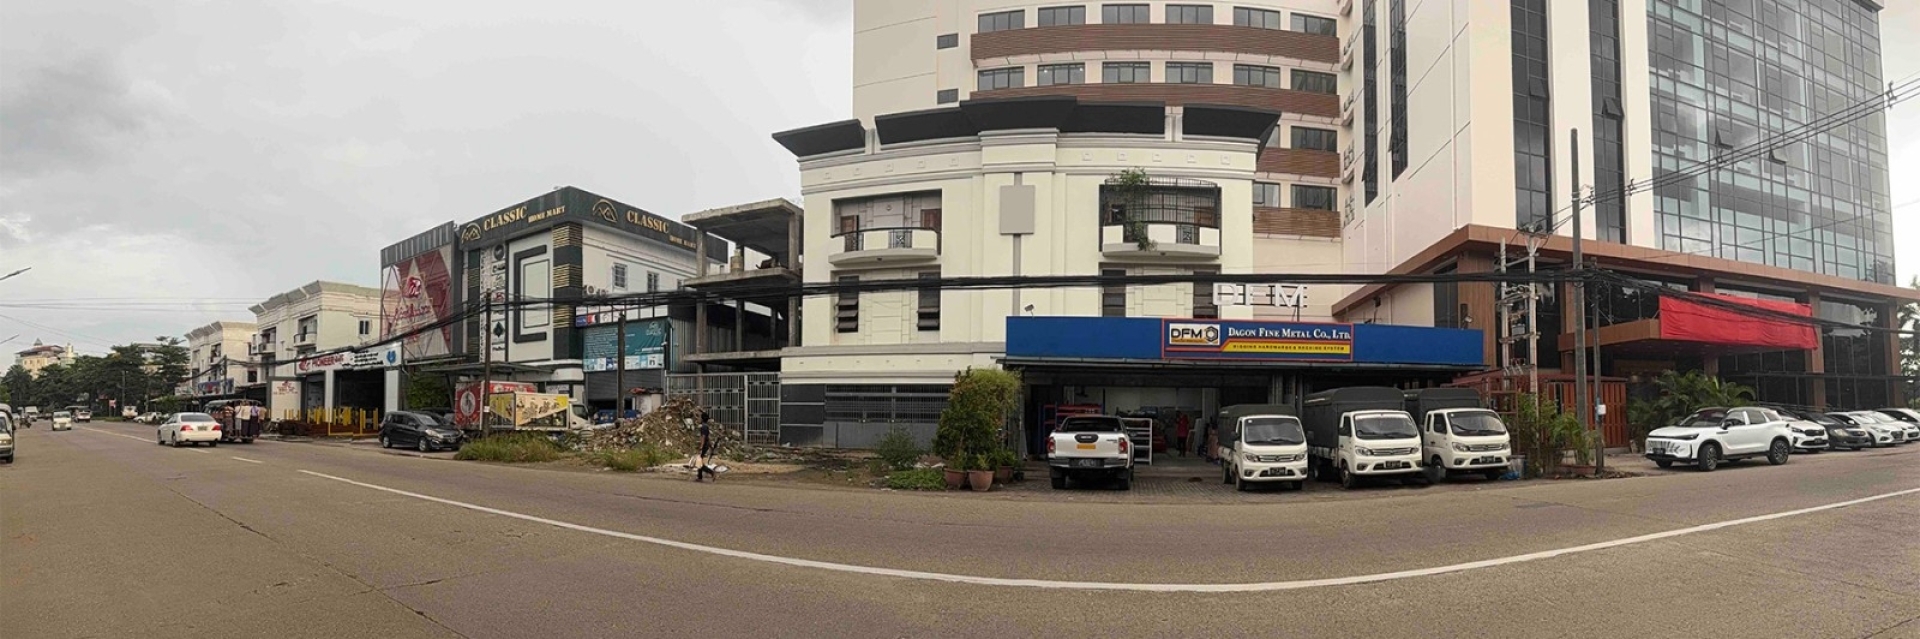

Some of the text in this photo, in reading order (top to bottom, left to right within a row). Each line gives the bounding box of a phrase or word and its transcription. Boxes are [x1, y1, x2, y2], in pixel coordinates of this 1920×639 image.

[483, 205, 566, 232] CLASSIC HOME MART
[626, 209, 669, 234] CLASSIC
[1213, 283, 1304, 308] DFM
[1171, 328, 1202, 339] DFM
[1228, 327, 1256, 337] DAGON
[1259, 328, 1280, 338] FINE
[1282, 328, 1311, 339] METAL
